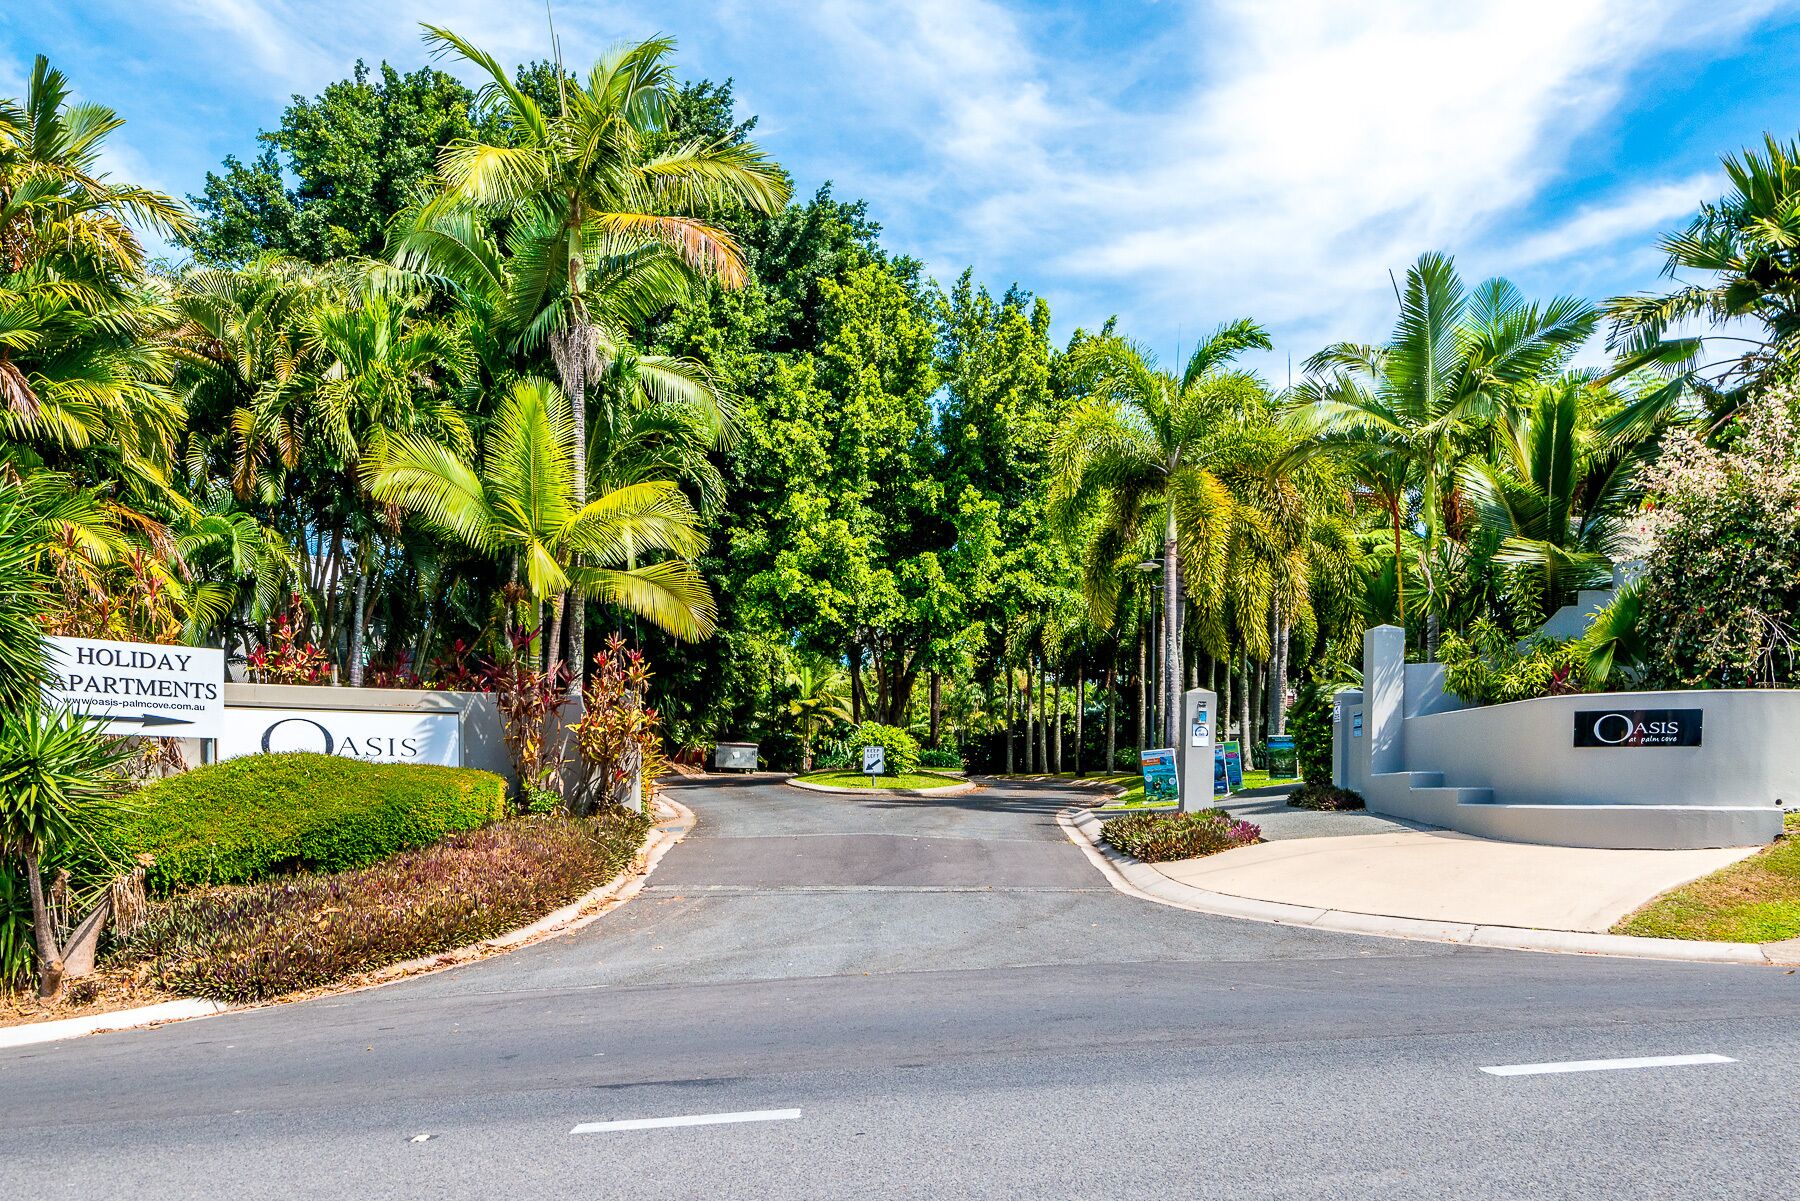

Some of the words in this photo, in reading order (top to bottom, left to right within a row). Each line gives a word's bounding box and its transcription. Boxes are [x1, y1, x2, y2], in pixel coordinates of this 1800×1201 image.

[76, 646, 192, 672] HOLIDAY
[49, 673, 218, 700] APARTMENTS
[261, 718, 418, 757] OASIS
[1593, 713, 1679, 744] OASIS
[1640, 735, 1660, 745] palm
